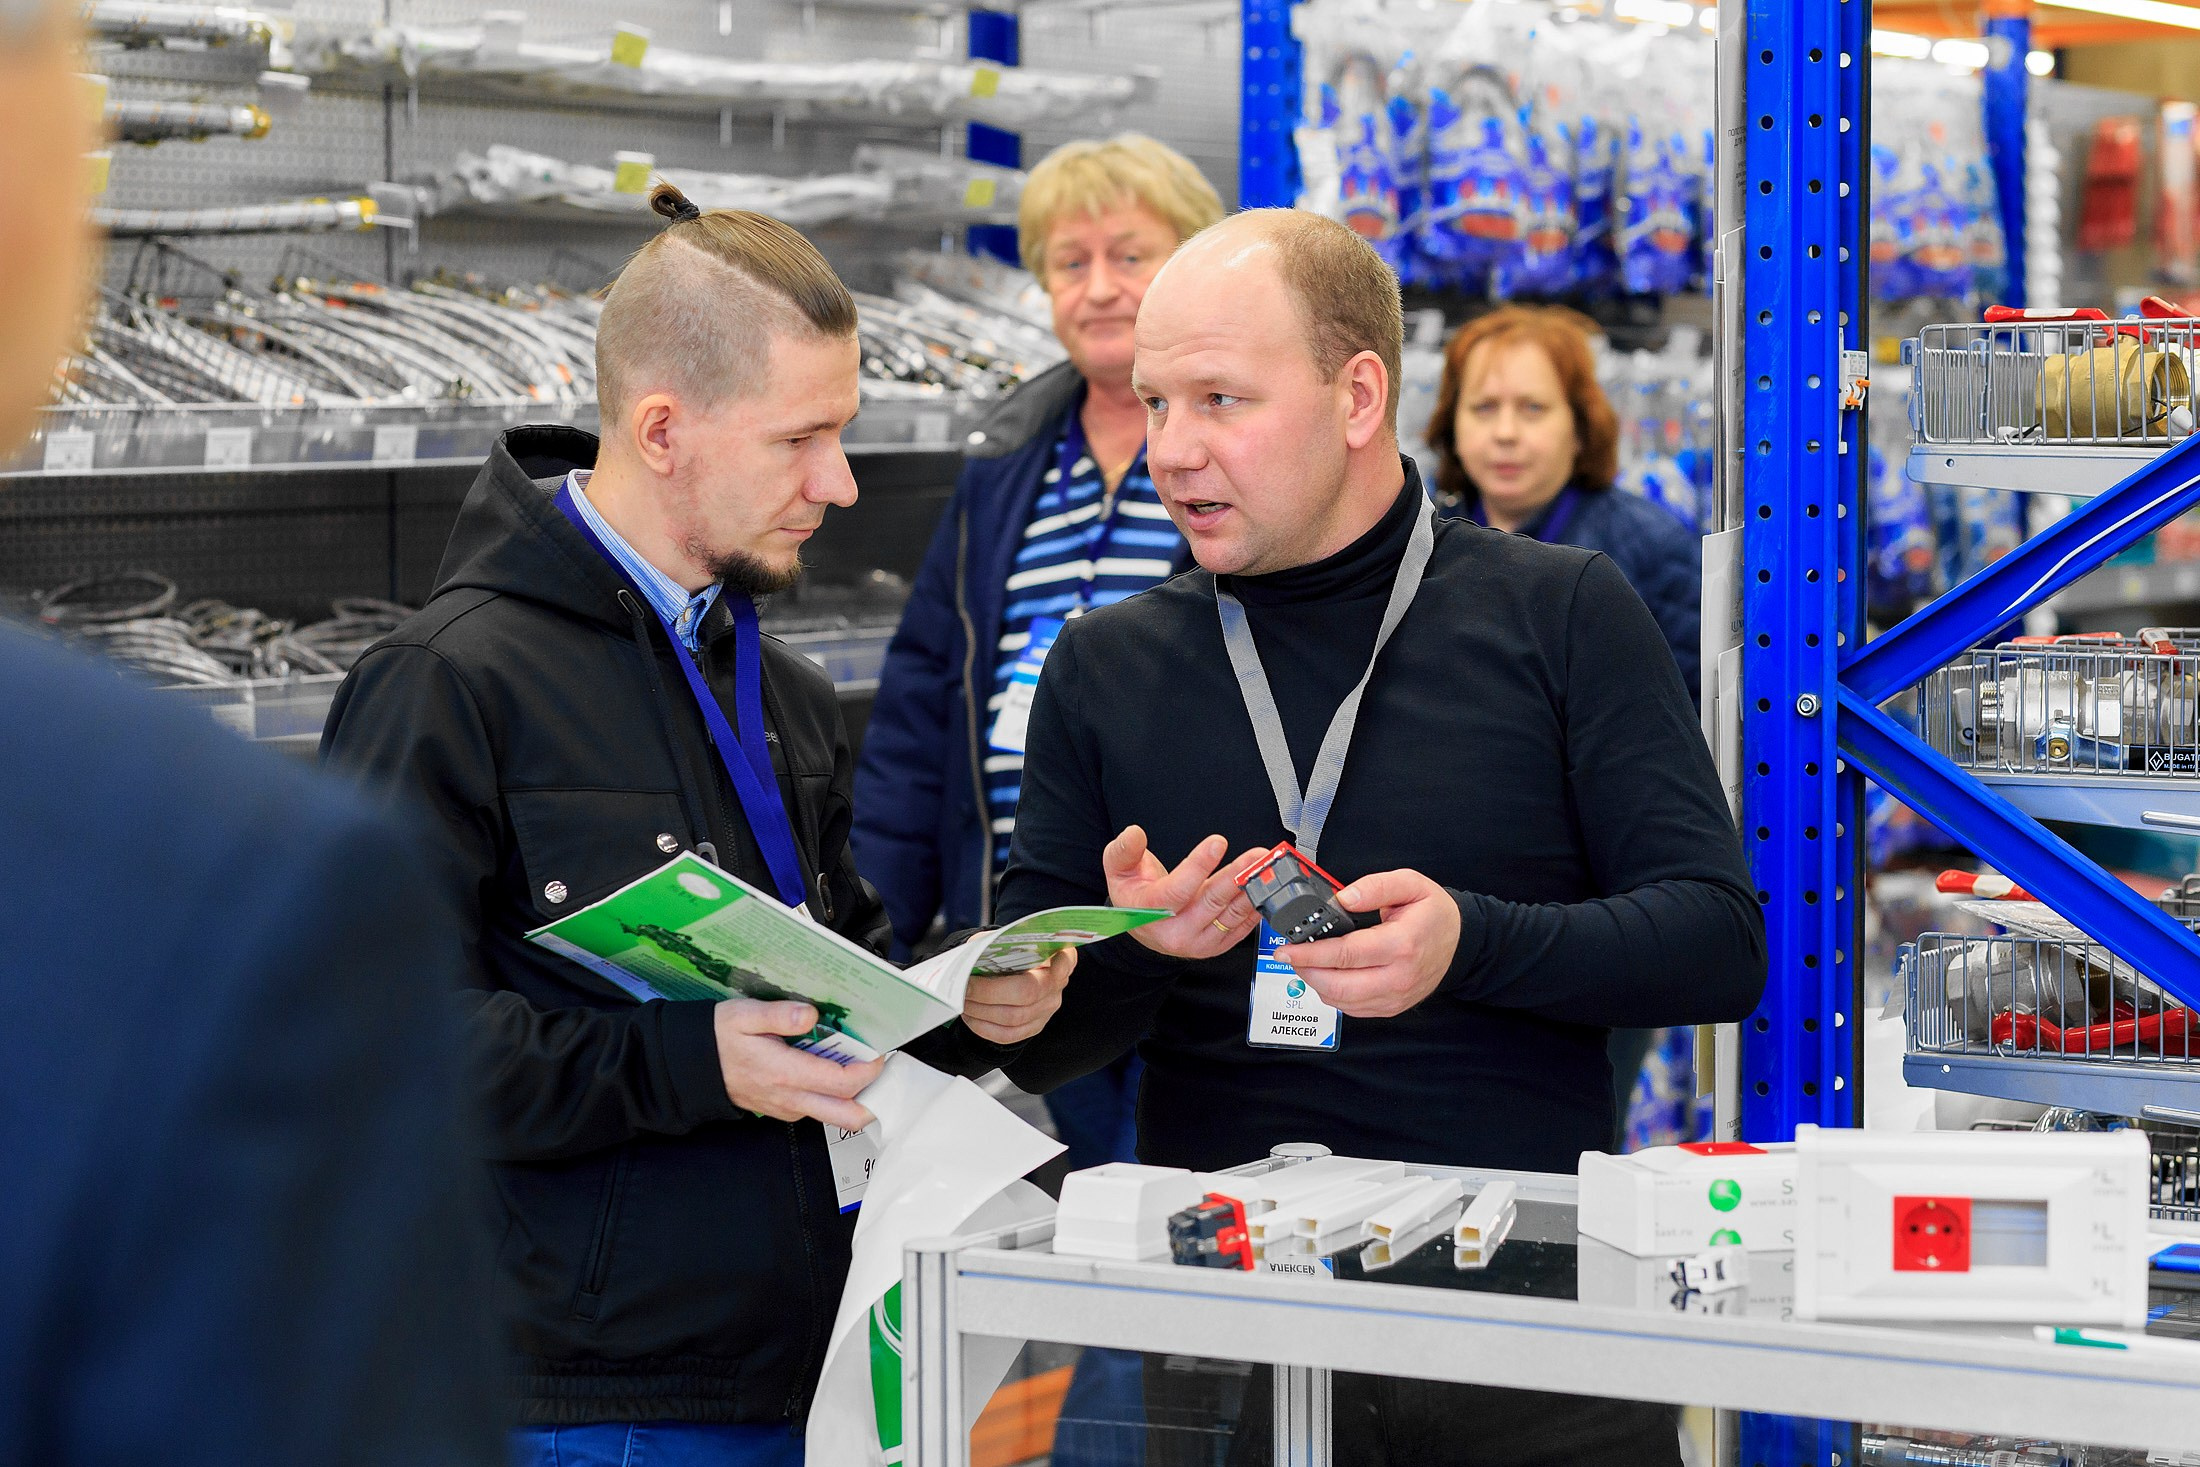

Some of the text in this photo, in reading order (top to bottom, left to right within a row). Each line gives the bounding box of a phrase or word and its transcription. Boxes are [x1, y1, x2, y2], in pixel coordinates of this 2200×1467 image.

[1286, 1000, 1304, 1009] SPL
[1272, 1011, 1319, 1023] Широков
[1271, 1025, 1317, 1037] АЛЕКСЕЙ
